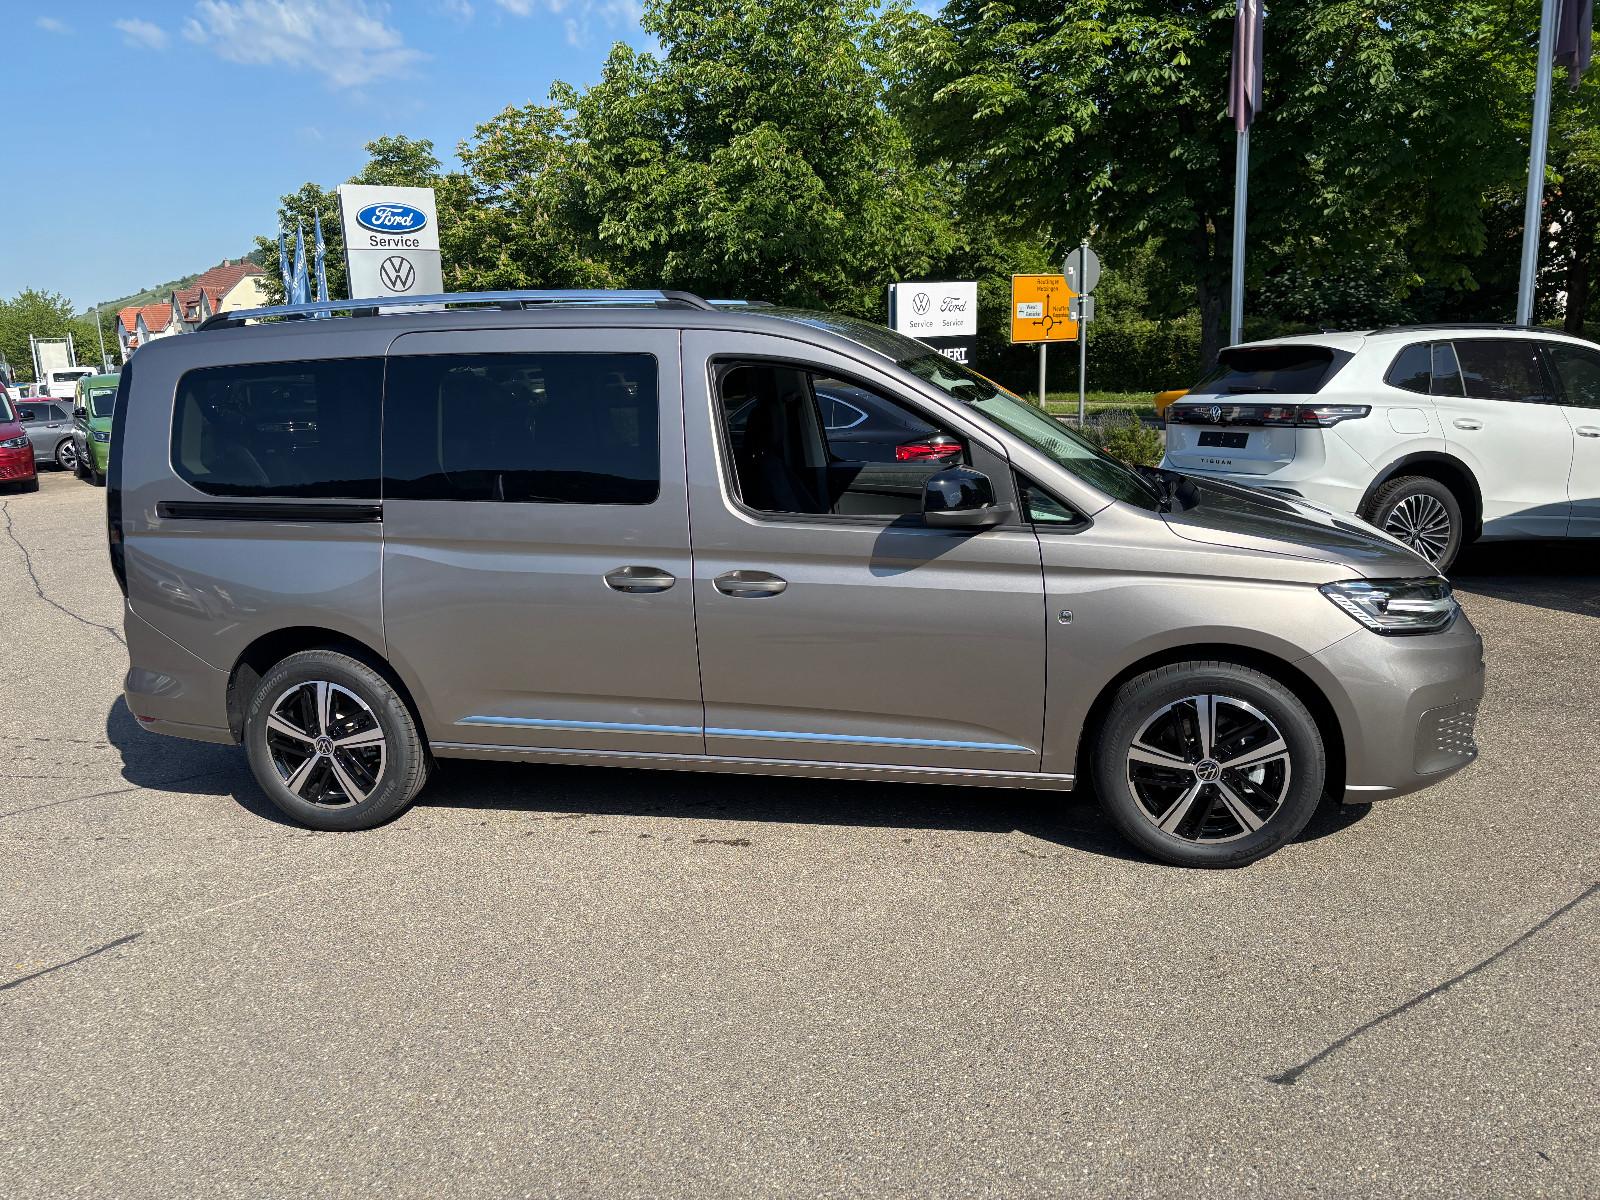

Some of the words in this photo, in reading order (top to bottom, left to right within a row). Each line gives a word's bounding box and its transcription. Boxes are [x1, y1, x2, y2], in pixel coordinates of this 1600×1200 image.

[372, 207, 414, 226] Ford
[369, 235, 420, 247] Service
[940, 296, 967, 313] Ford
[909, 320, 934, 328] Service
[942, 318, 964, 327] Service
